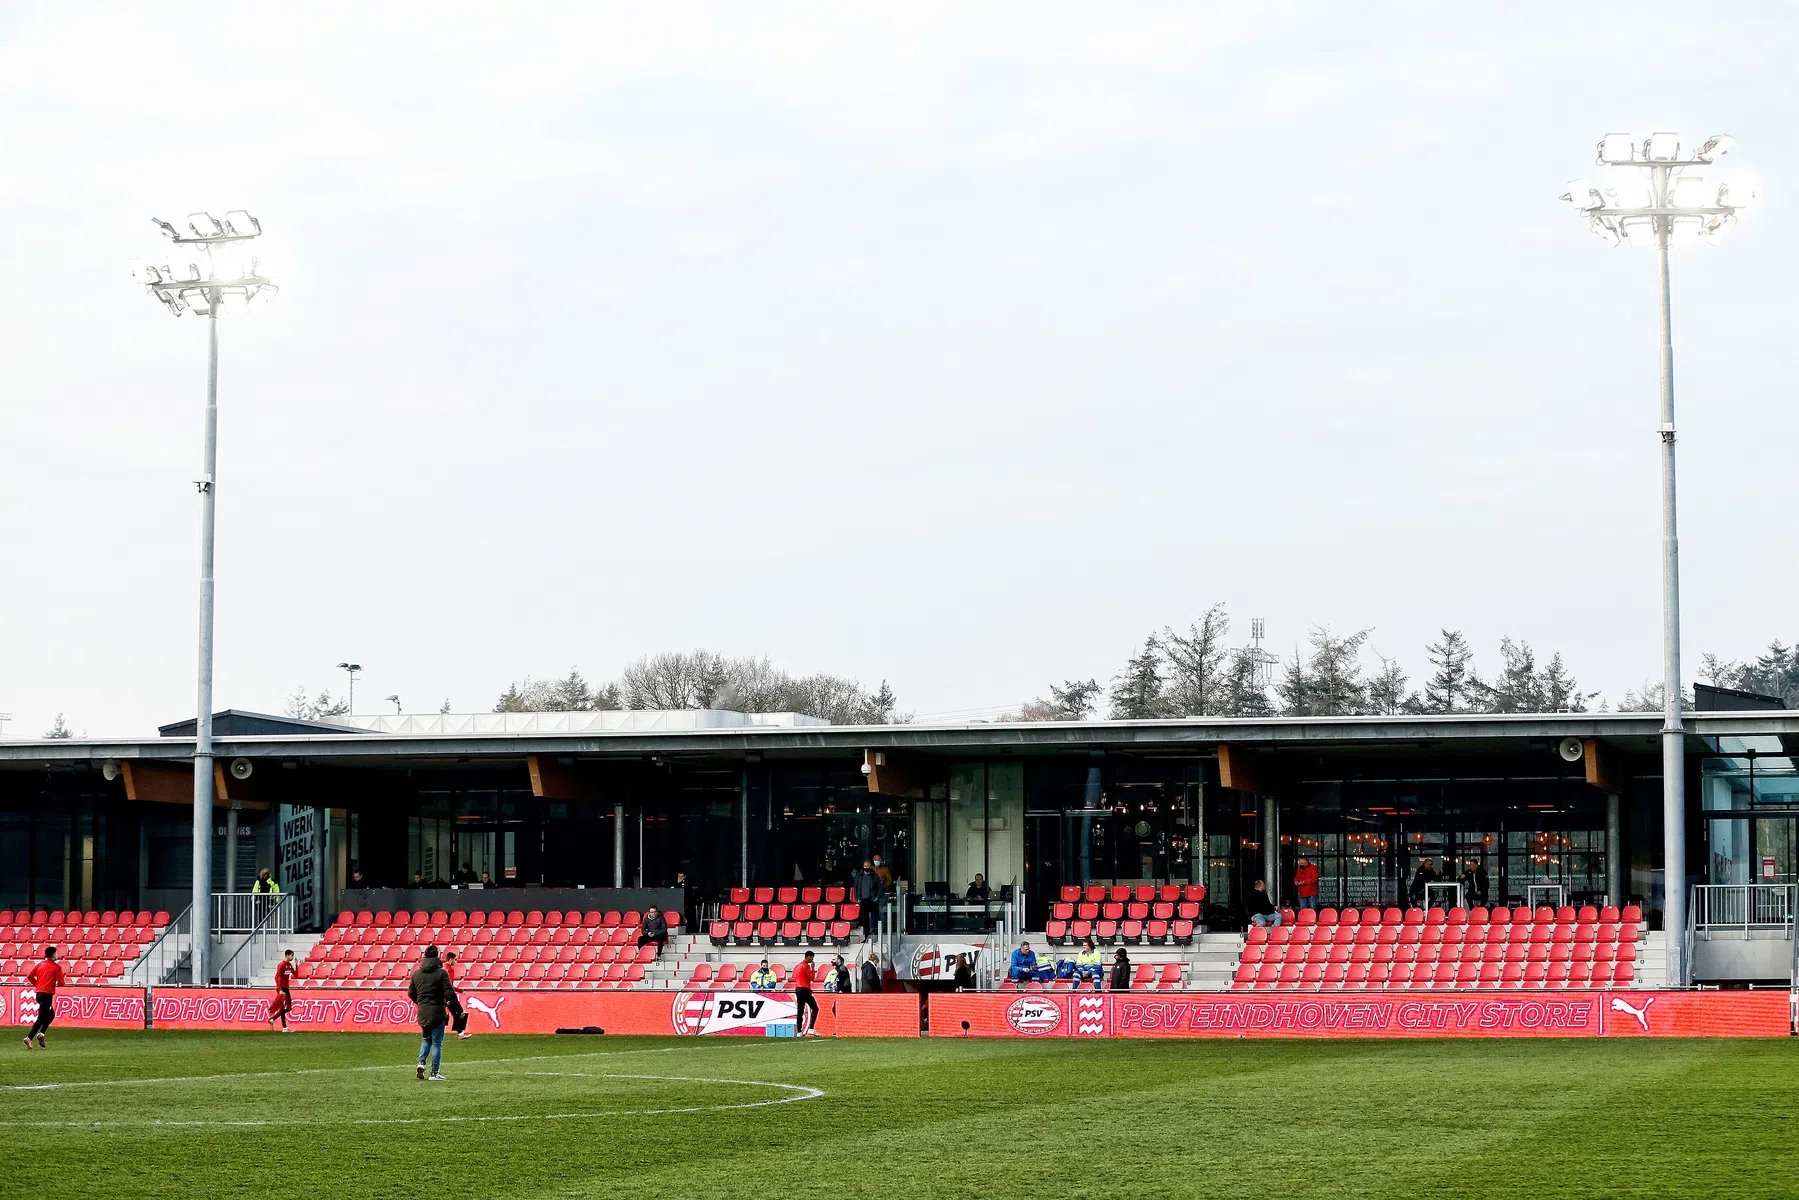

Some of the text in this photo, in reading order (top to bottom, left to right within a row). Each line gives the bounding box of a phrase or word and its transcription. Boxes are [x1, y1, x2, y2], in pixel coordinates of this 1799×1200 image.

[284, 813, 313, 840] WERK
[285, 856, 314, 885] TALEN
[55, 995, 101, 1018] PSV
[285, 999, 352, 1021] CITY
[717, 1000, 765, 1018] PSV
[1122, 1003, 1592, 1028] PSV EINDHOVEN CITY STORE
